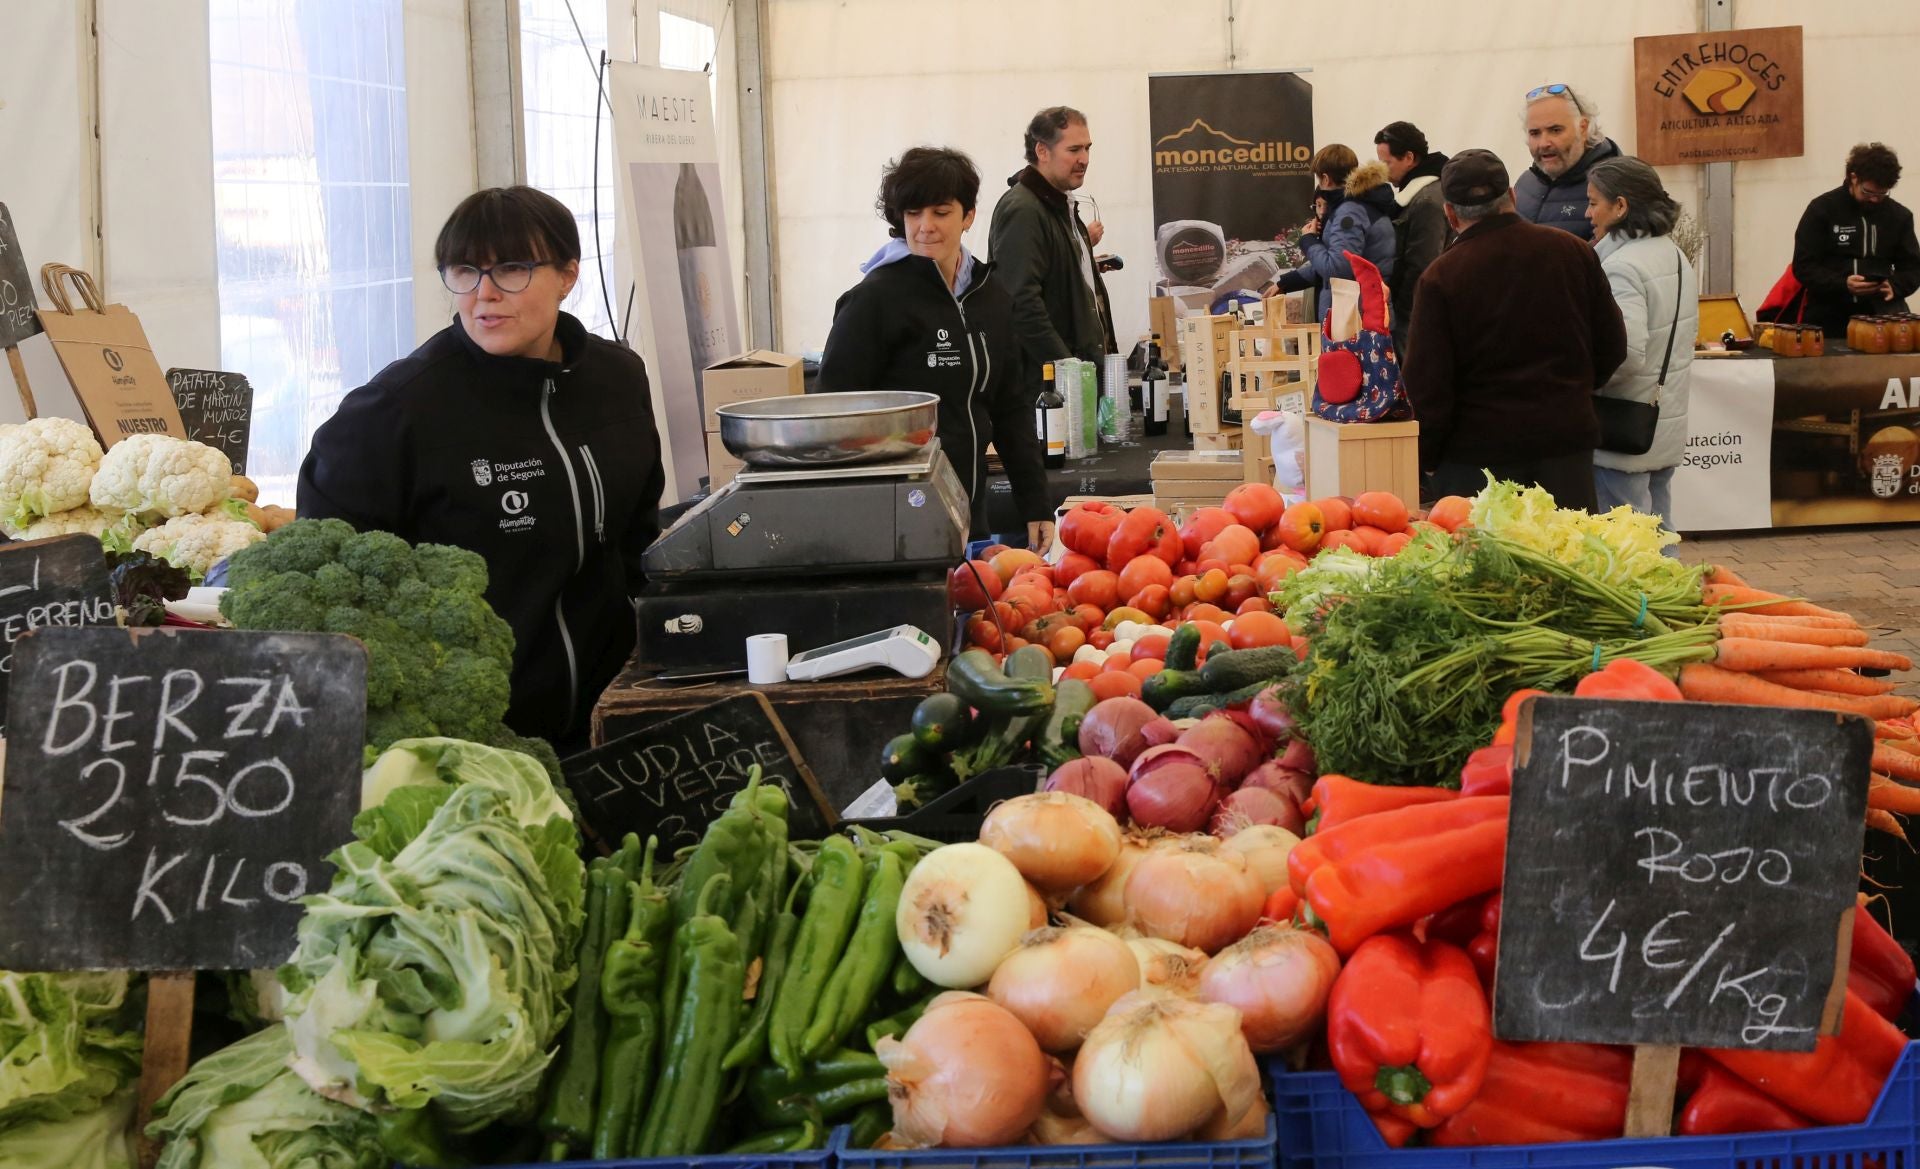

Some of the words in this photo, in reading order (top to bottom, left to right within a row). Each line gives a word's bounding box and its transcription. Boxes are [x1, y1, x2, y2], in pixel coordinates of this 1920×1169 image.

[1654, 42, 1786, 98] ENTREHOCES
[636, 94, 697, 123] MAESTE
[1660, 117, 1720, 131] APICULTURA
[1726, 114, 1780, 125] ARTESANA
[1155, 141, 1311, 166] moncedillo
[1156, 165, 1210, 174] ARTESANO
[1213, 163, 1259, 172] NATURAL
[1262, 162, 1277, 170] DE
[1279, 161, 1311, 169] OVEJA
[172, 371, 228, 395] PATATAS
[177, 392, 196, 411] DE
[116, 417, 168, 434] NUESTRO
[203, 407, 248, 424] MUÑOZ
[1685, 431, 1742, 447] utación
[494, 458, 543, 473] Diputación
[1682, 451, 1743, 470] Segovia
[497, 473, 509, 482] de
[510, 469, 545, 481] Segovia
[41, 658, 313, 757] BERZA
[575, 722, 740, 802] JUDIA
[639, 741, 790, 808] VERDE
[57, 750, 296, 851] 2'50
[131, 846, 309, 925] KILO
